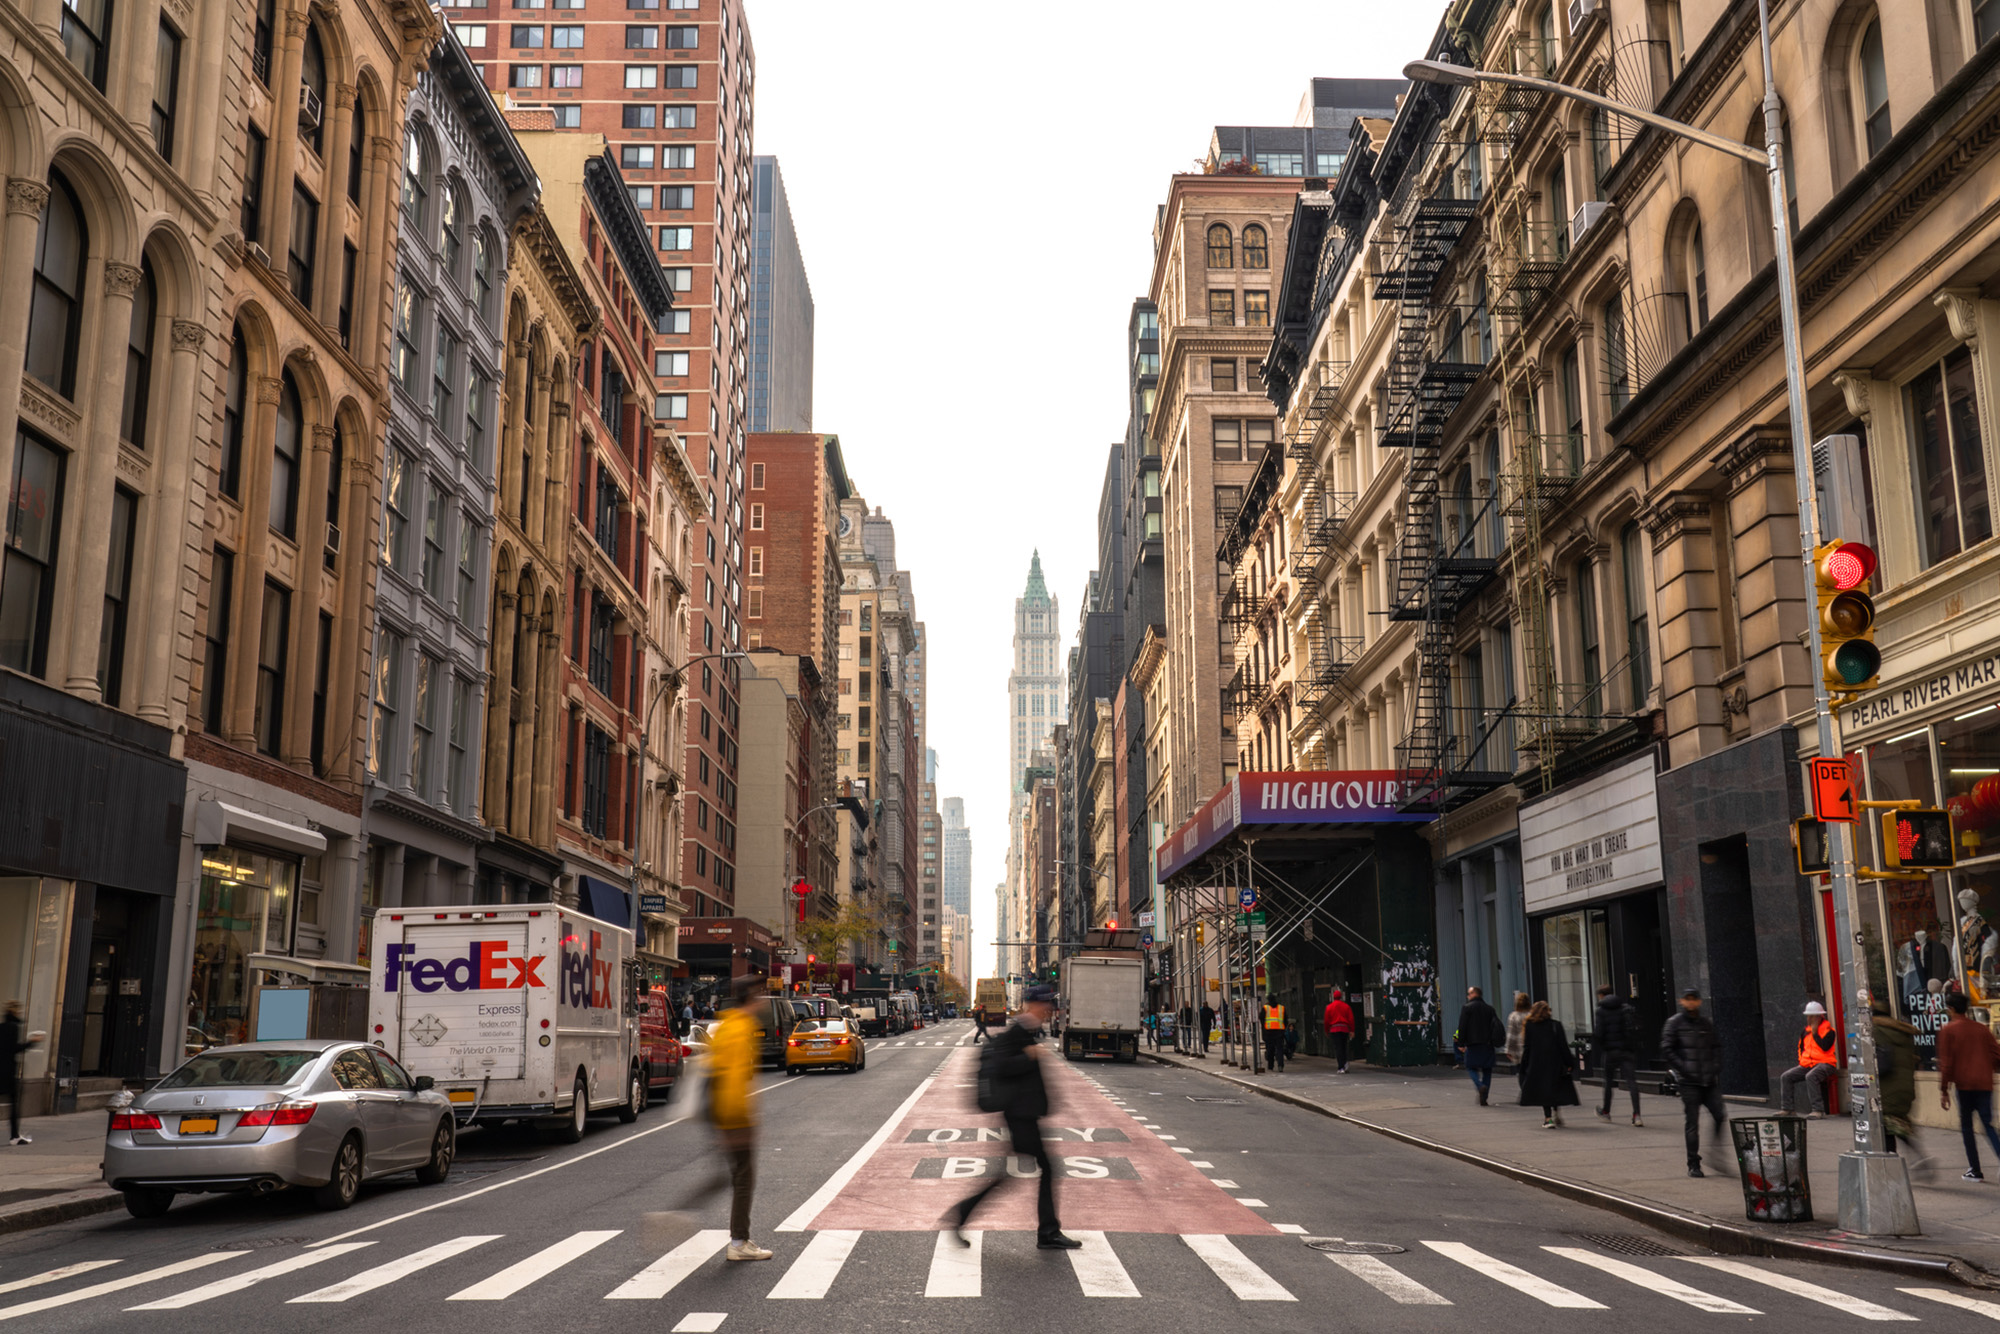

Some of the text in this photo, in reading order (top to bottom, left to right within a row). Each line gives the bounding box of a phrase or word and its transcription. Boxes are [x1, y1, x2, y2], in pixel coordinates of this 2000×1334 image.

[1852, 696, 1900, 729] PEARL
[1903, 675, 1951, 712] RIVER
[1551, 832, 1627, 872] YOU ARE WHAT YOU CREATE
[384, 940, 547, 992] FedEx
[560, 922, 613, 1010] FedEx
[478, 1004, 521, 1016] Express
[478, 1020, 517, 1028] fedex.com
[1914, 1034, 1936, 1046] MART
[463, 1046, 484, 1054] World
[486, 1046, 496, 1054] On
[926, 1128, 1096, 1142] ONY
[941, 1156, 1110, 1179] BUS
